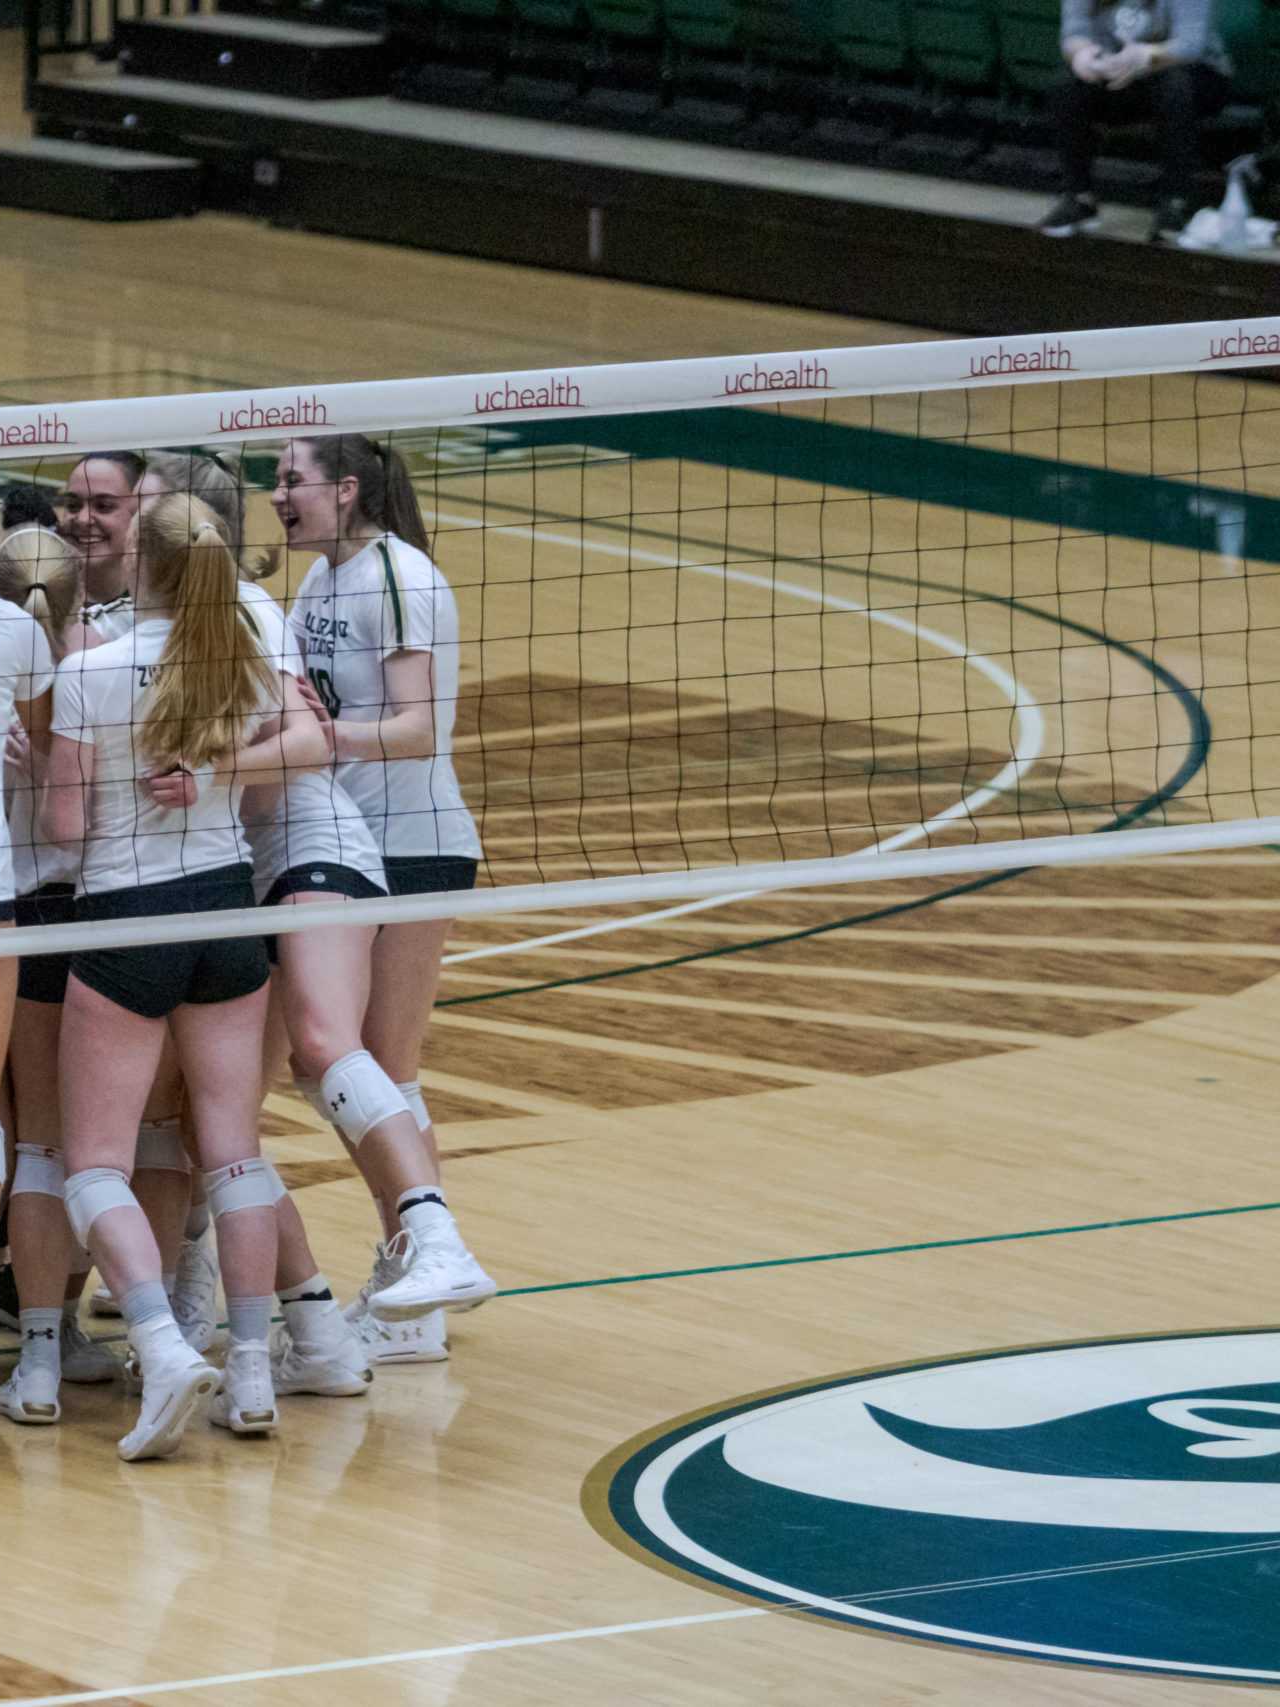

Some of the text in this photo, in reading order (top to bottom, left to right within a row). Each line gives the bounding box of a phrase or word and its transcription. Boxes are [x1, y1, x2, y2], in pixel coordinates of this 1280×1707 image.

[970, 340, 1072, 377] uchealth
[1210, 327, 1280, 358] uchea
[475, 375, 581, 412] uchealth
[724, 358, 828, 395] uchealth
[219, 394, 327, 431] uchealth
